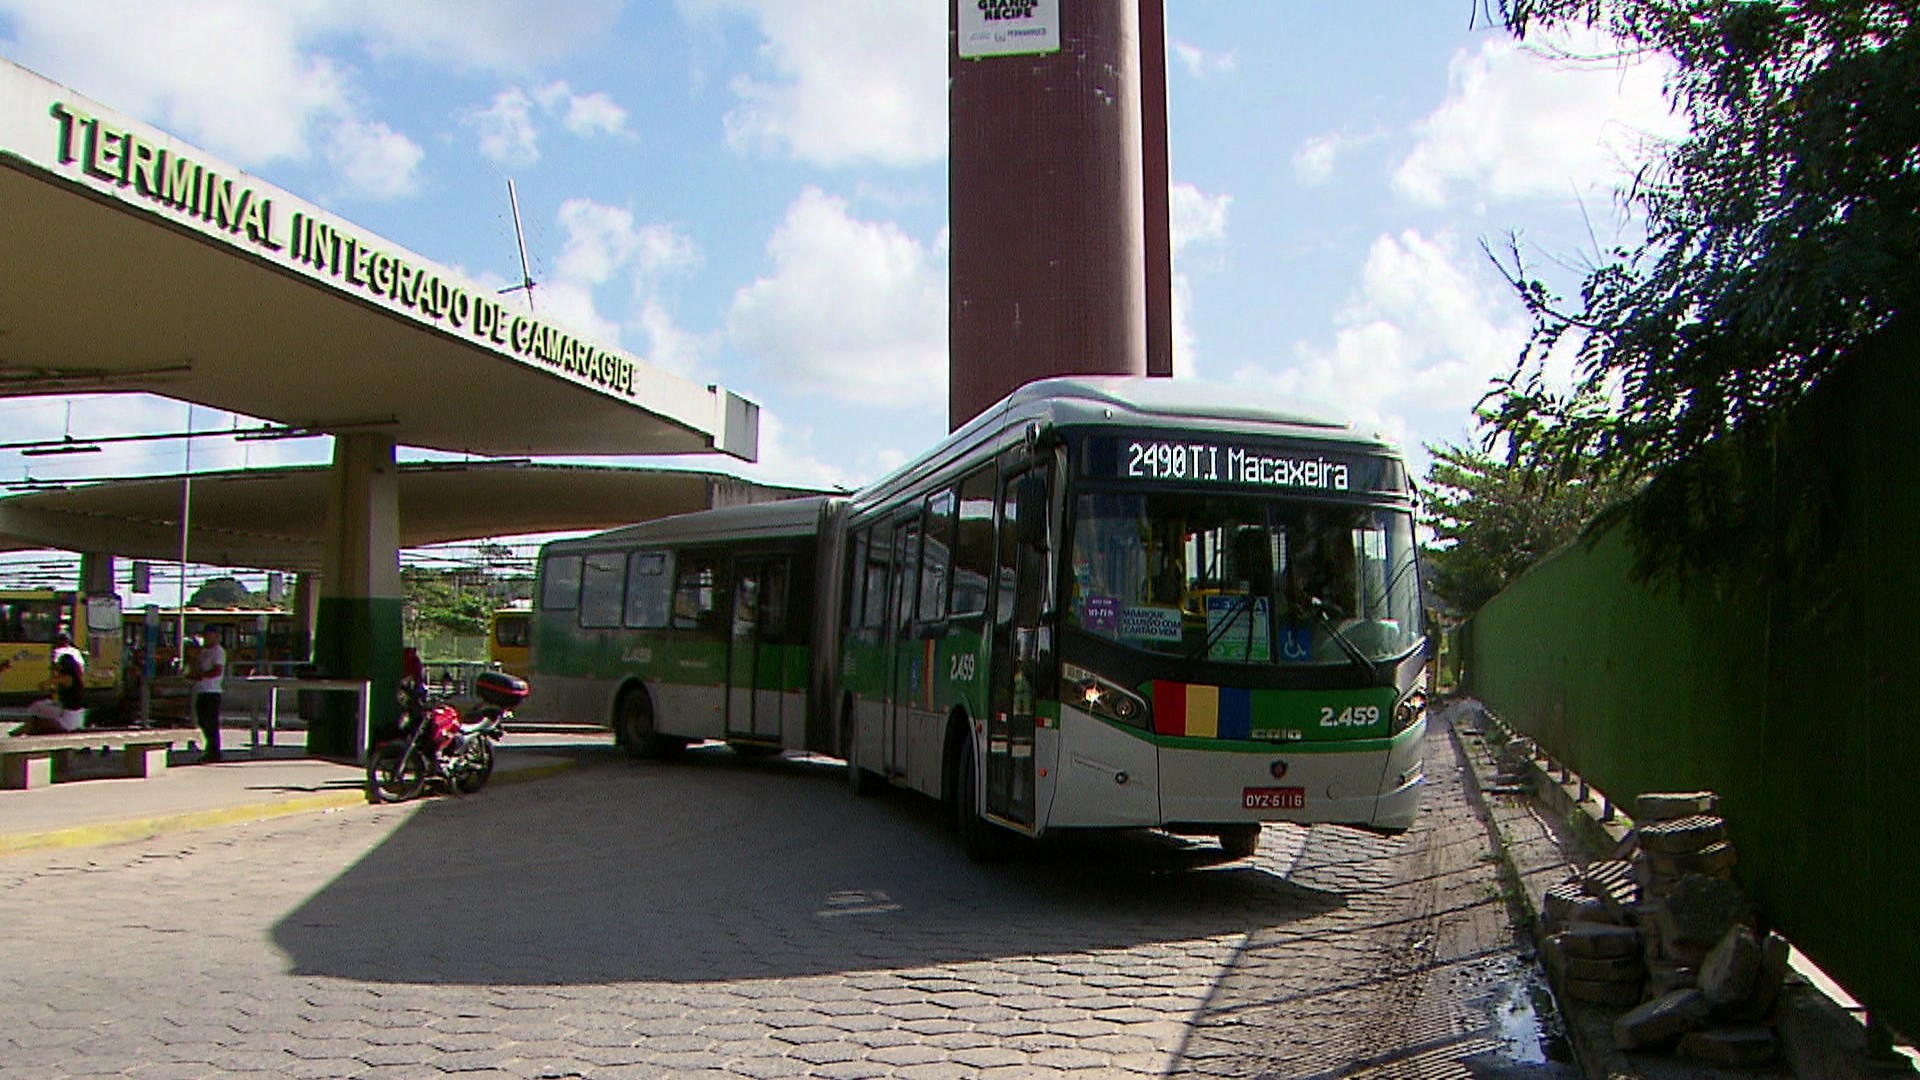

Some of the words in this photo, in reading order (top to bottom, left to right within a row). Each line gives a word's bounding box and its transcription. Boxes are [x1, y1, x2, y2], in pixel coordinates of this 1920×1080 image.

[49, 101, 282, 251] TERMINAL
[290, 212, 469, 328] INTEGRADO
[473, 297, 509, 344] DE
[510, 316, 639, 396] CAMARAGIBE
[1227, 447, 1349, 490] Macaxeira
[950, 653, 975, 681] 2.459
[1320, 706, 1380, 727] 2.459
